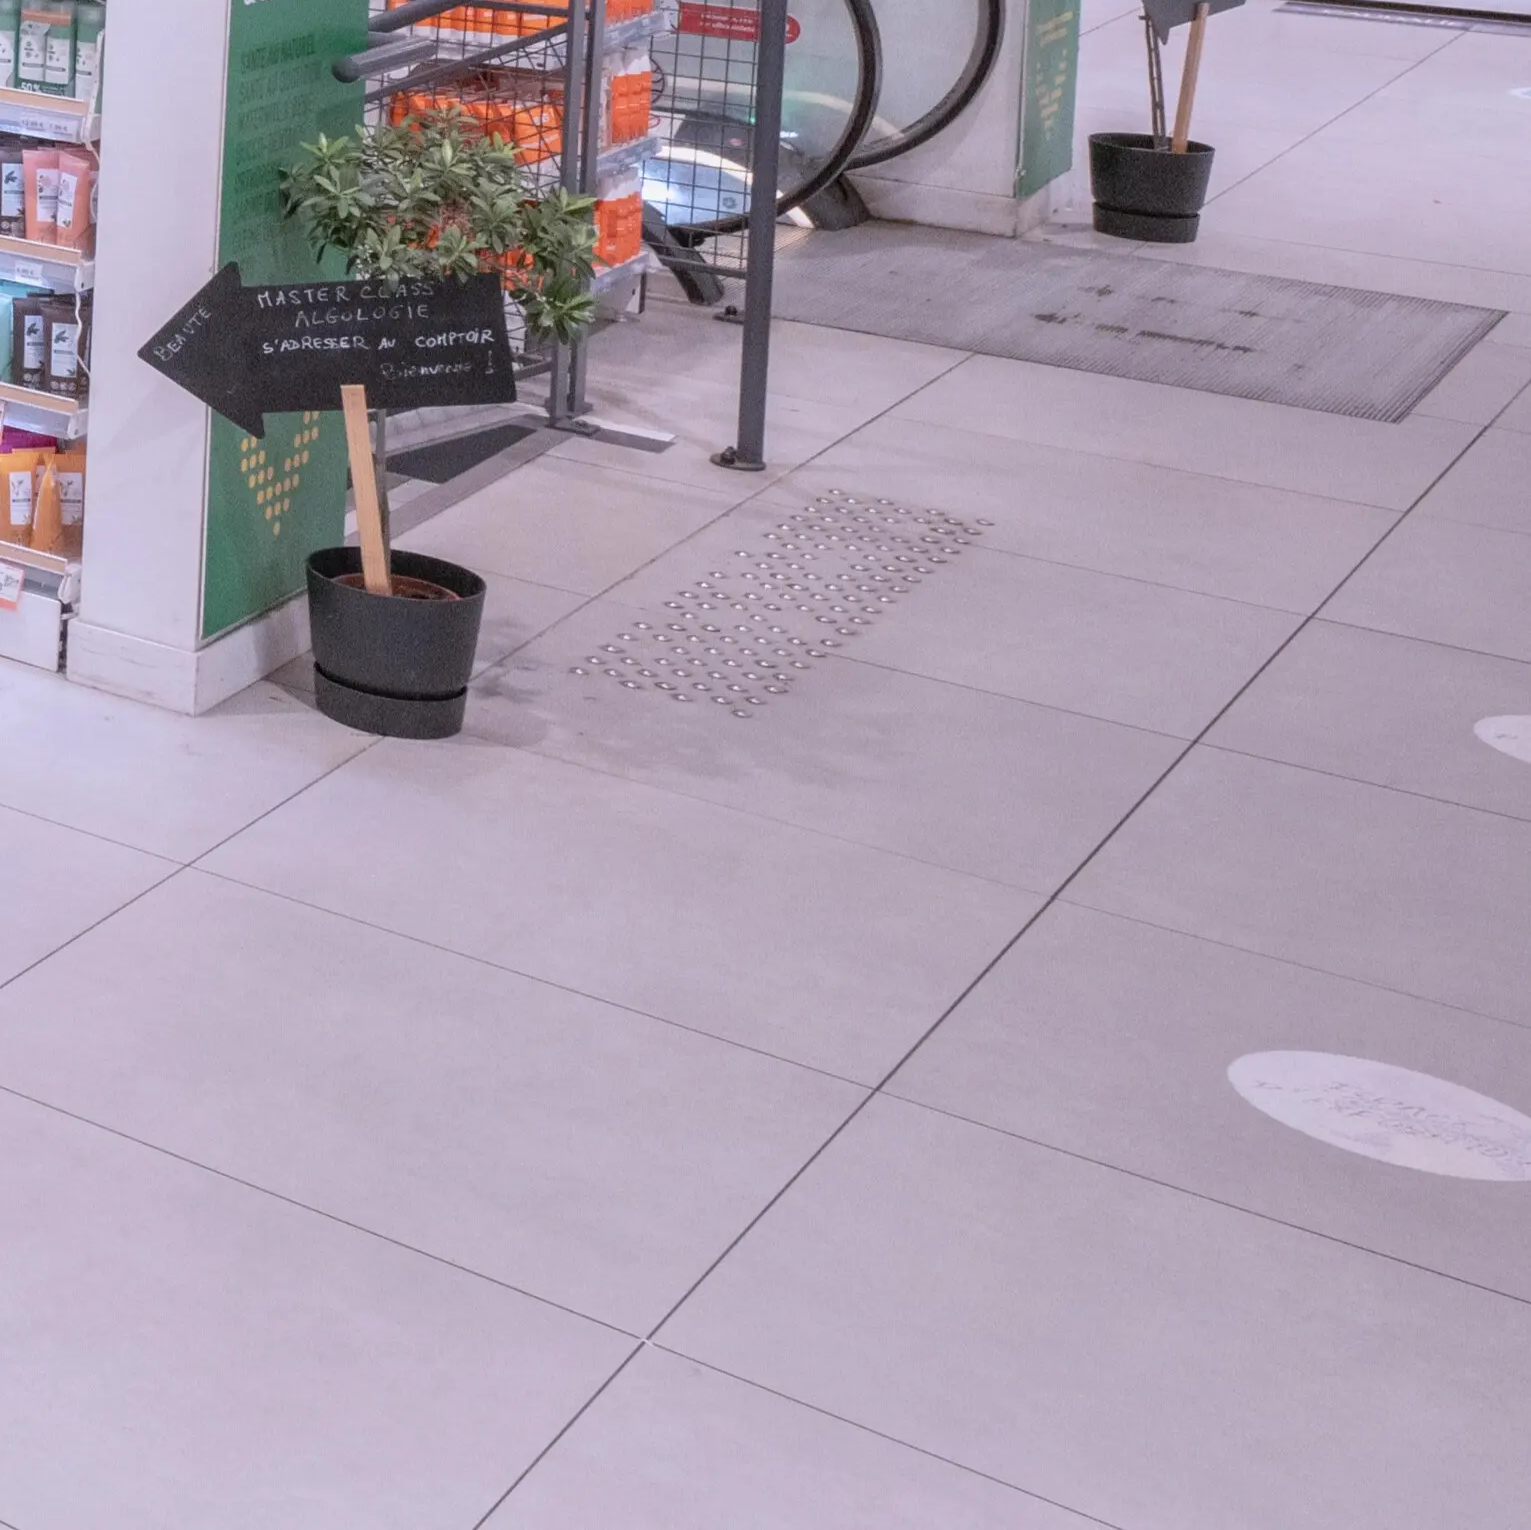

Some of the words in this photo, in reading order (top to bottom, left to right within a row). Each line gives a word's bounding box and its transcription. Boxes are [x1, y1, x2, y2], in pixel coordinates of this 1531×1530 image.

[258, 287, 351, 309] MASTER
[153, 305, 211, 363] BEAUTÉ
[262, 337, 367, 355] S'ADRESSER
[378, 338, 397, 350] AU
[415, 328, 496, 348] COMPTOIR
